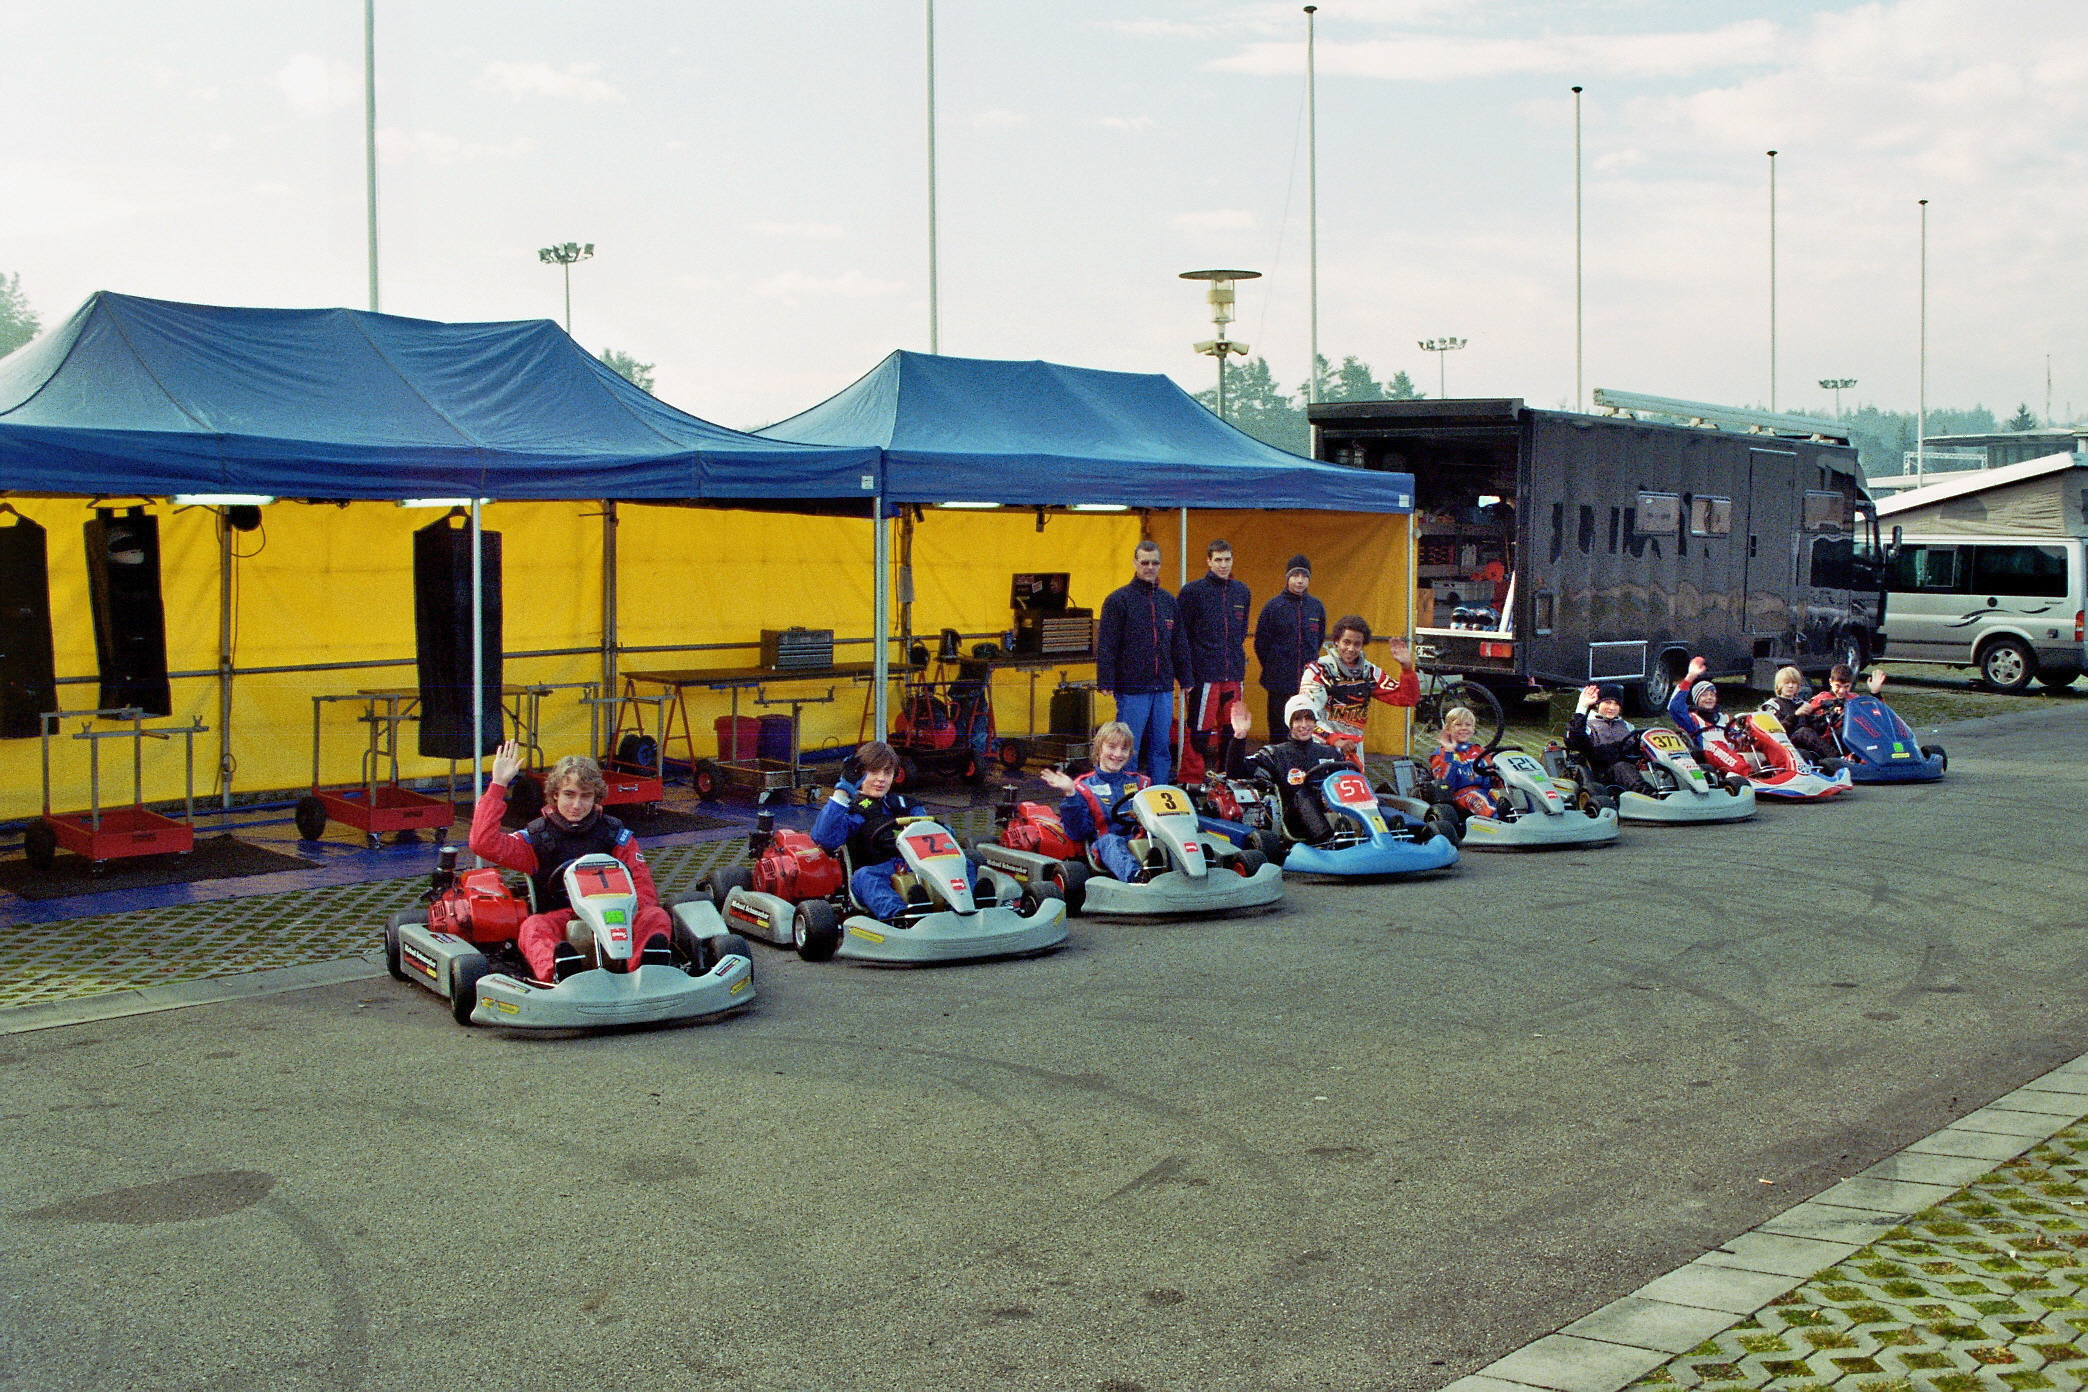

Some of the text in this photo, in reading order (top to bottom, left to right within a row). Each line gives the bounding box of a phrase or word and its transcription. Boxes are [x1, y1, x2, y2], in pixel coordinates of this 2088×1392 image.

[1652, 735, 1682, 748] 377
[1507, 757, 1537, 771] 121
[1160, 792, 1177, 810] 3
[921, 835, 943, 853] 2
[592, 869, 609, 889] 1
